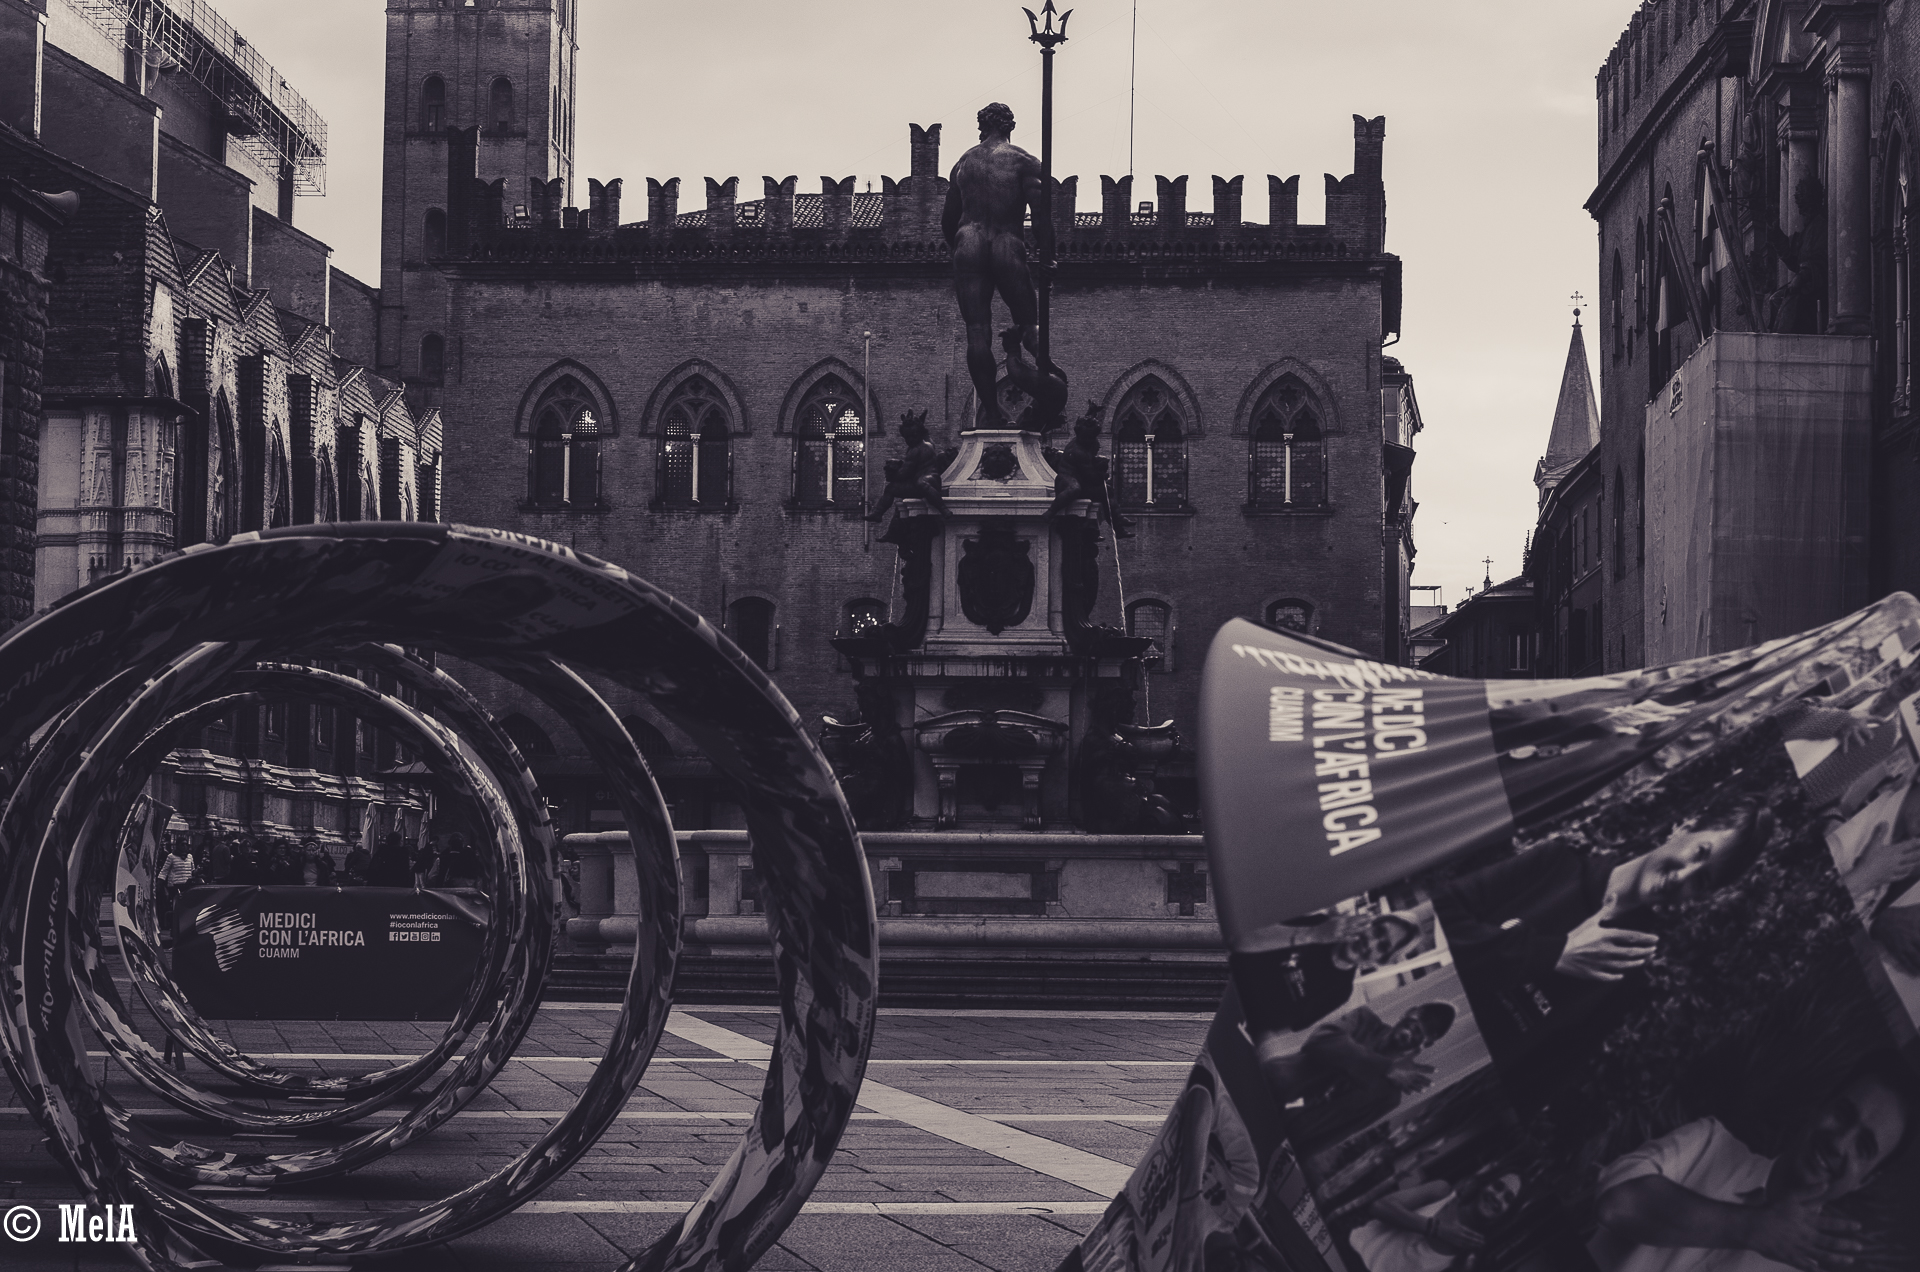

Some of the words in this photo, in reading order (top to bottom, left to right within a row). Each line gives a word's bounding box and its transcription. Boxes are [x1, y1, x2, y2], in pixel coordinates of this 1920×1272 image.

[480, 558, 520, 572] CO
[555, 564, 640, 611] PROGETT
[258, 912, 316, 929] MEDICI
[389, 921, 439, 929] #ioconlafrica
[258, 929, 291, 946] CON
[298, 930, 366, 947] L’AFRICA
[258, 947, 300, 959] CUAMM
